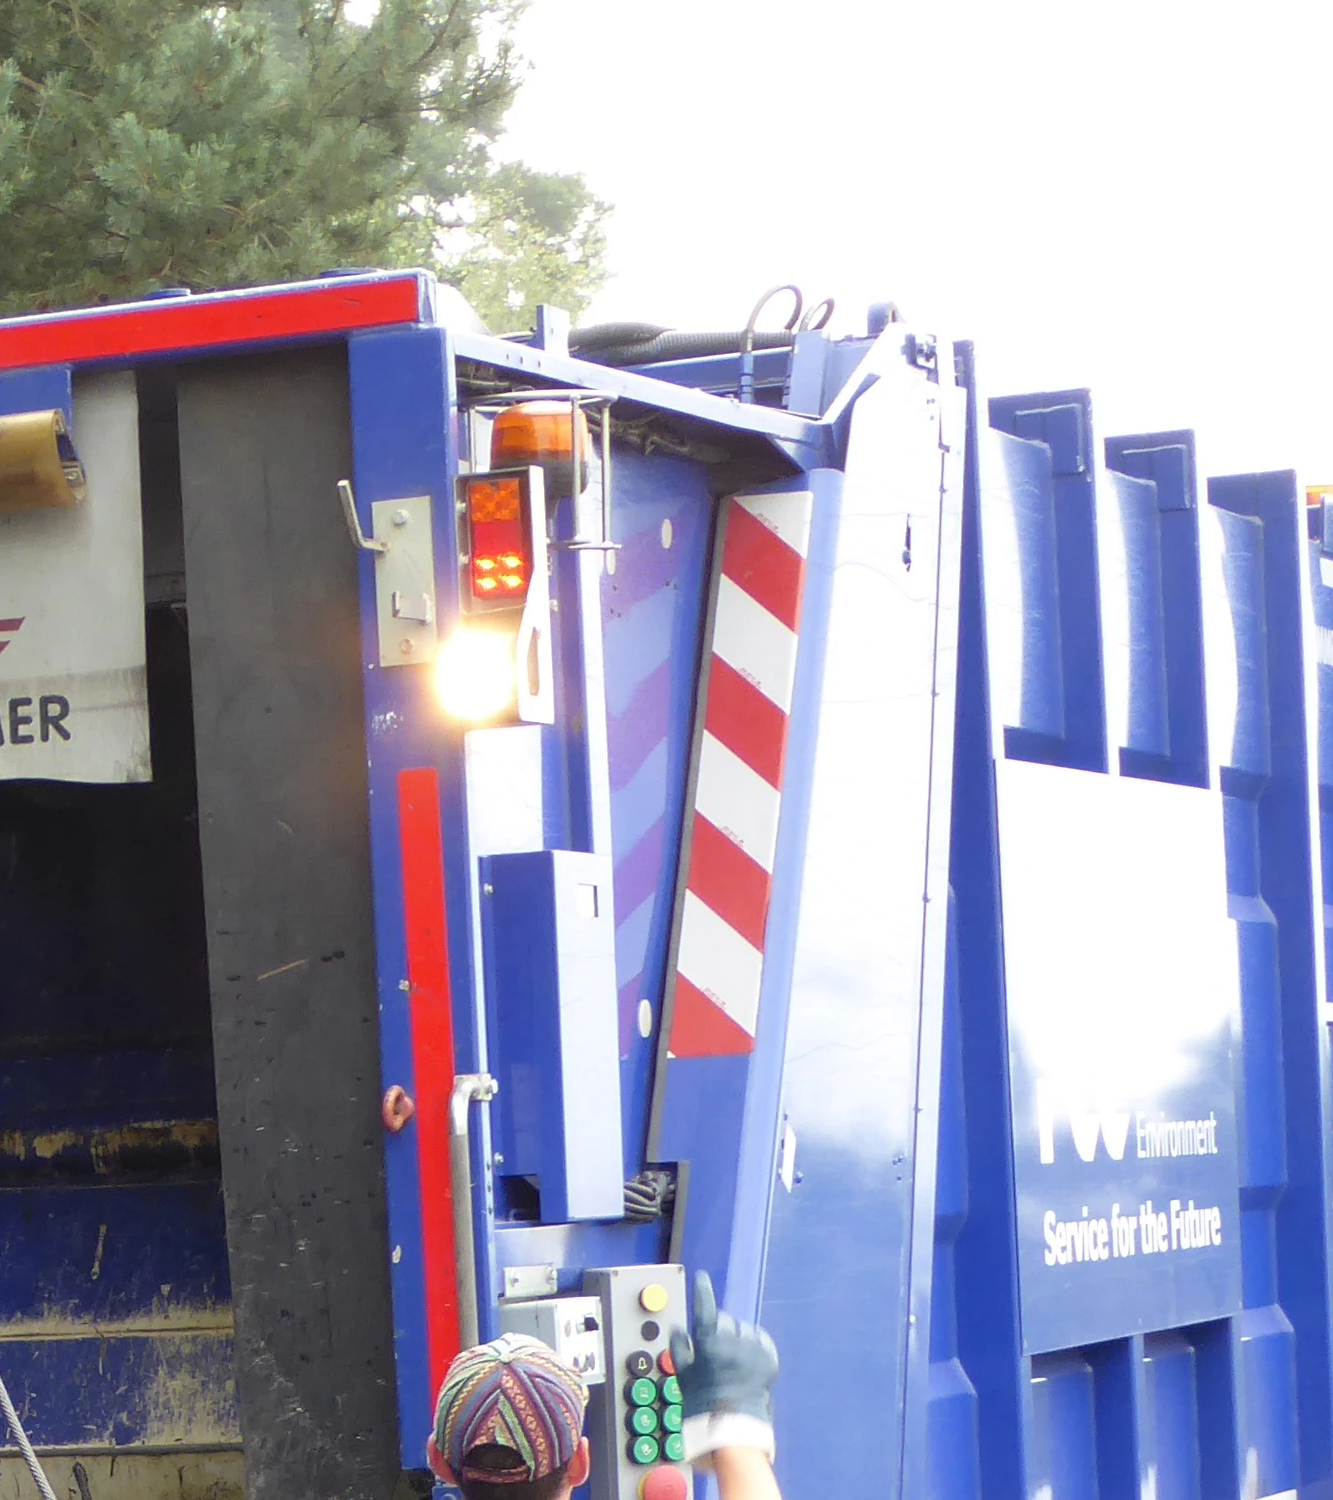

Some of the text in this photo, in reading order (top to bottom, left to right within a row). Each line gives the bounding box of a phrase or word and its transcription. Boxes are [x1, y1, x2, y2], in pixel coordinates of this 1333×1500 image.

[1136, 1111, 1219, 1159] Environment
[1043, 1199, 1222, 1266] Service for the Future
